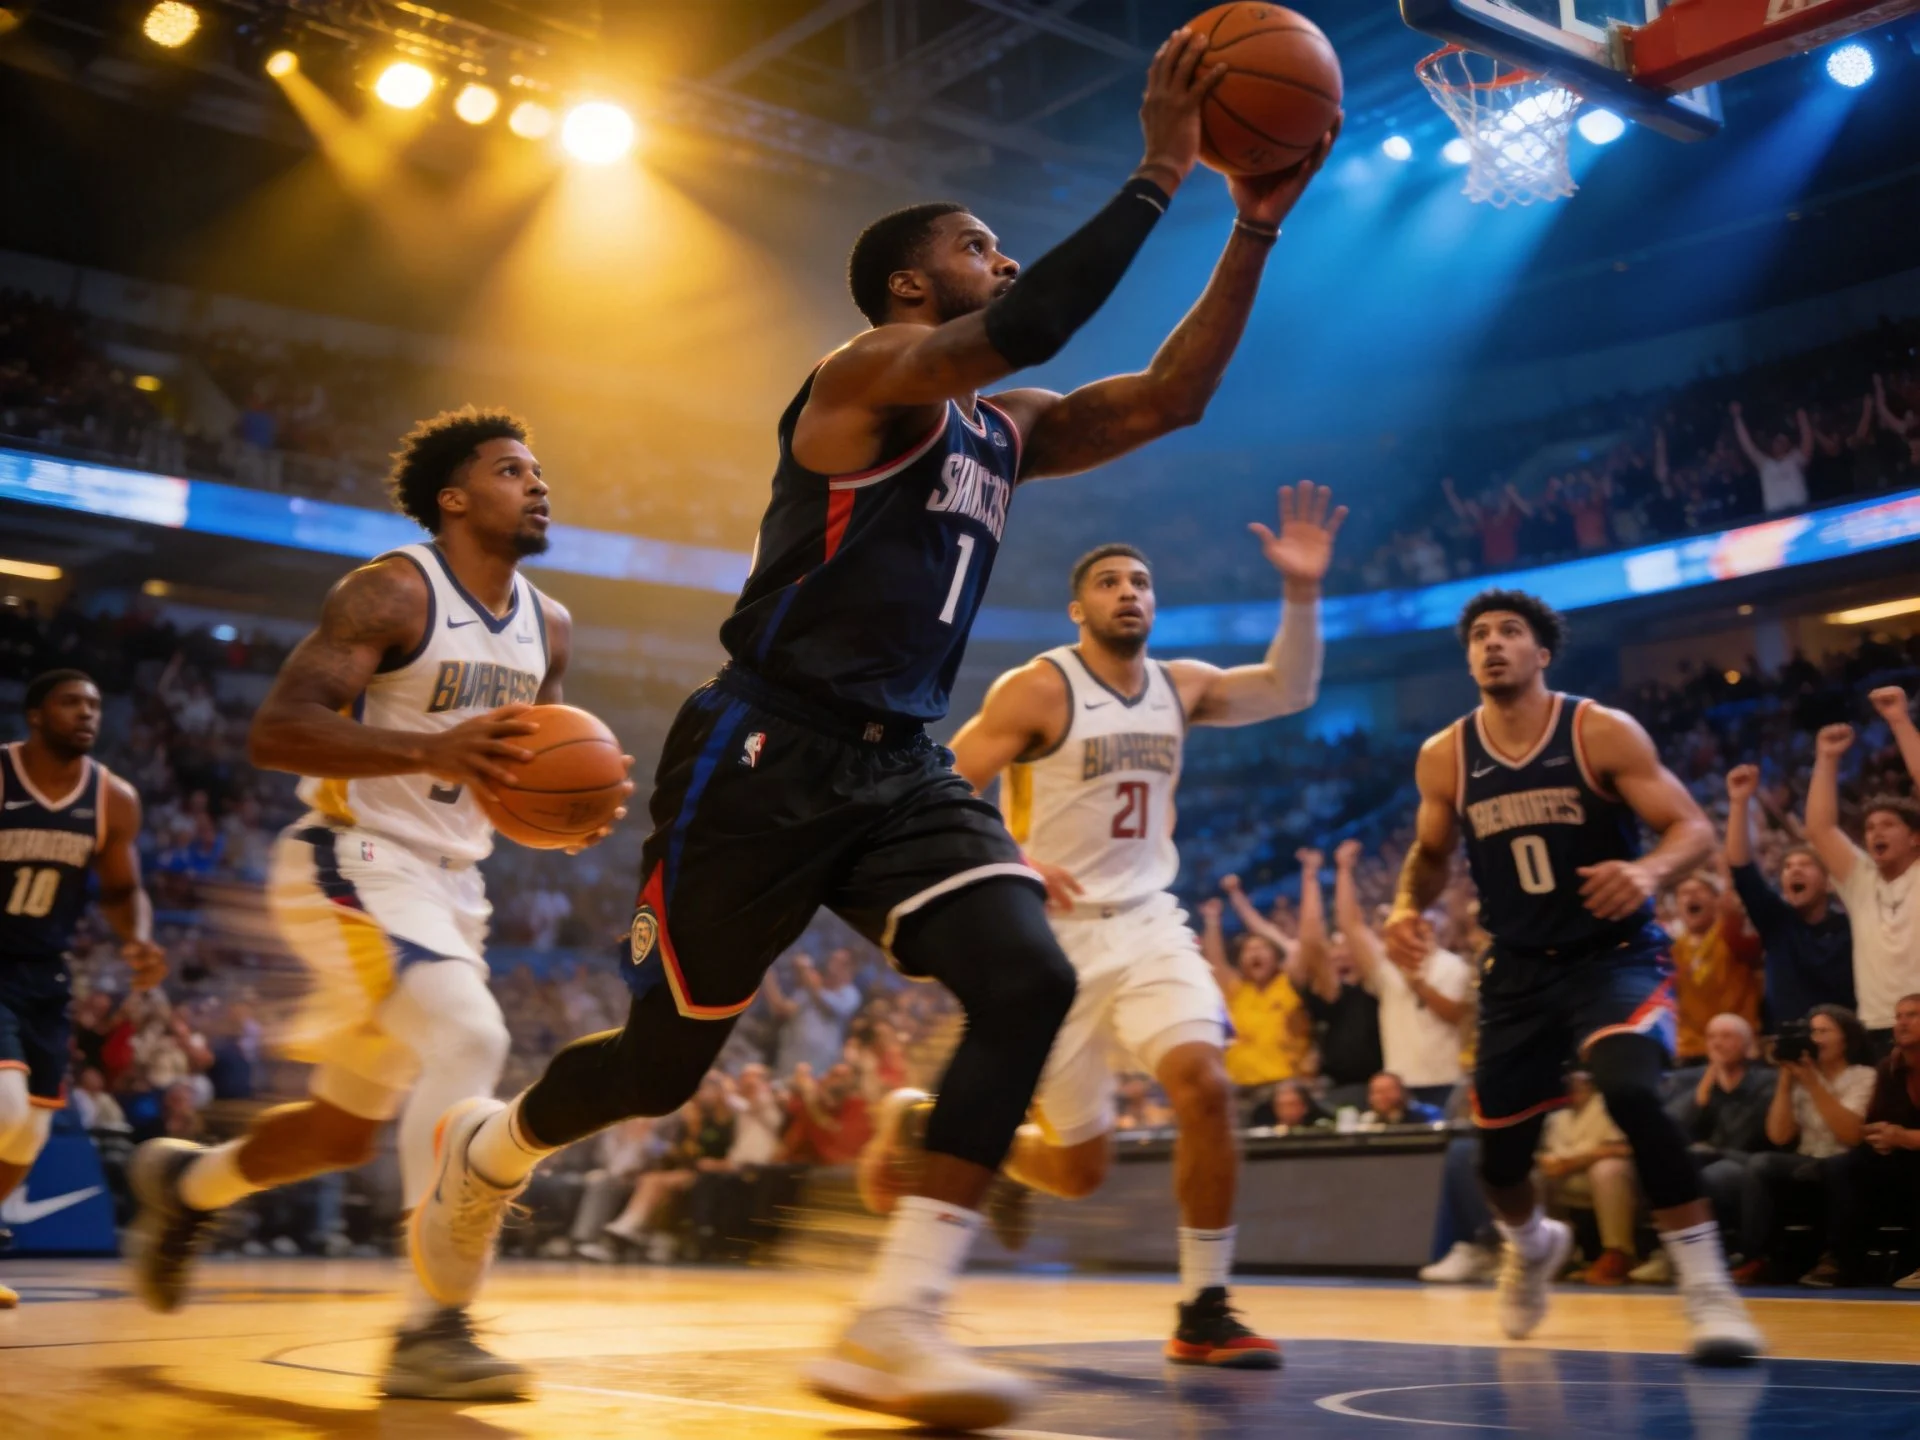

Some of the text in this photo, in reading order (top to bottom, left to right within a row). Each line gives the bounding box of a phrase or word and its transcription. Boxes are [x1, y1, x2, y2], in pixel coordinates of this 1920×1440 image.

[939, 533, 975, 624] 1
[1111, 782, 1149, 839] 21
[5, 866, 61, 918] 10
[1510, 835, 1556, 895] 0
